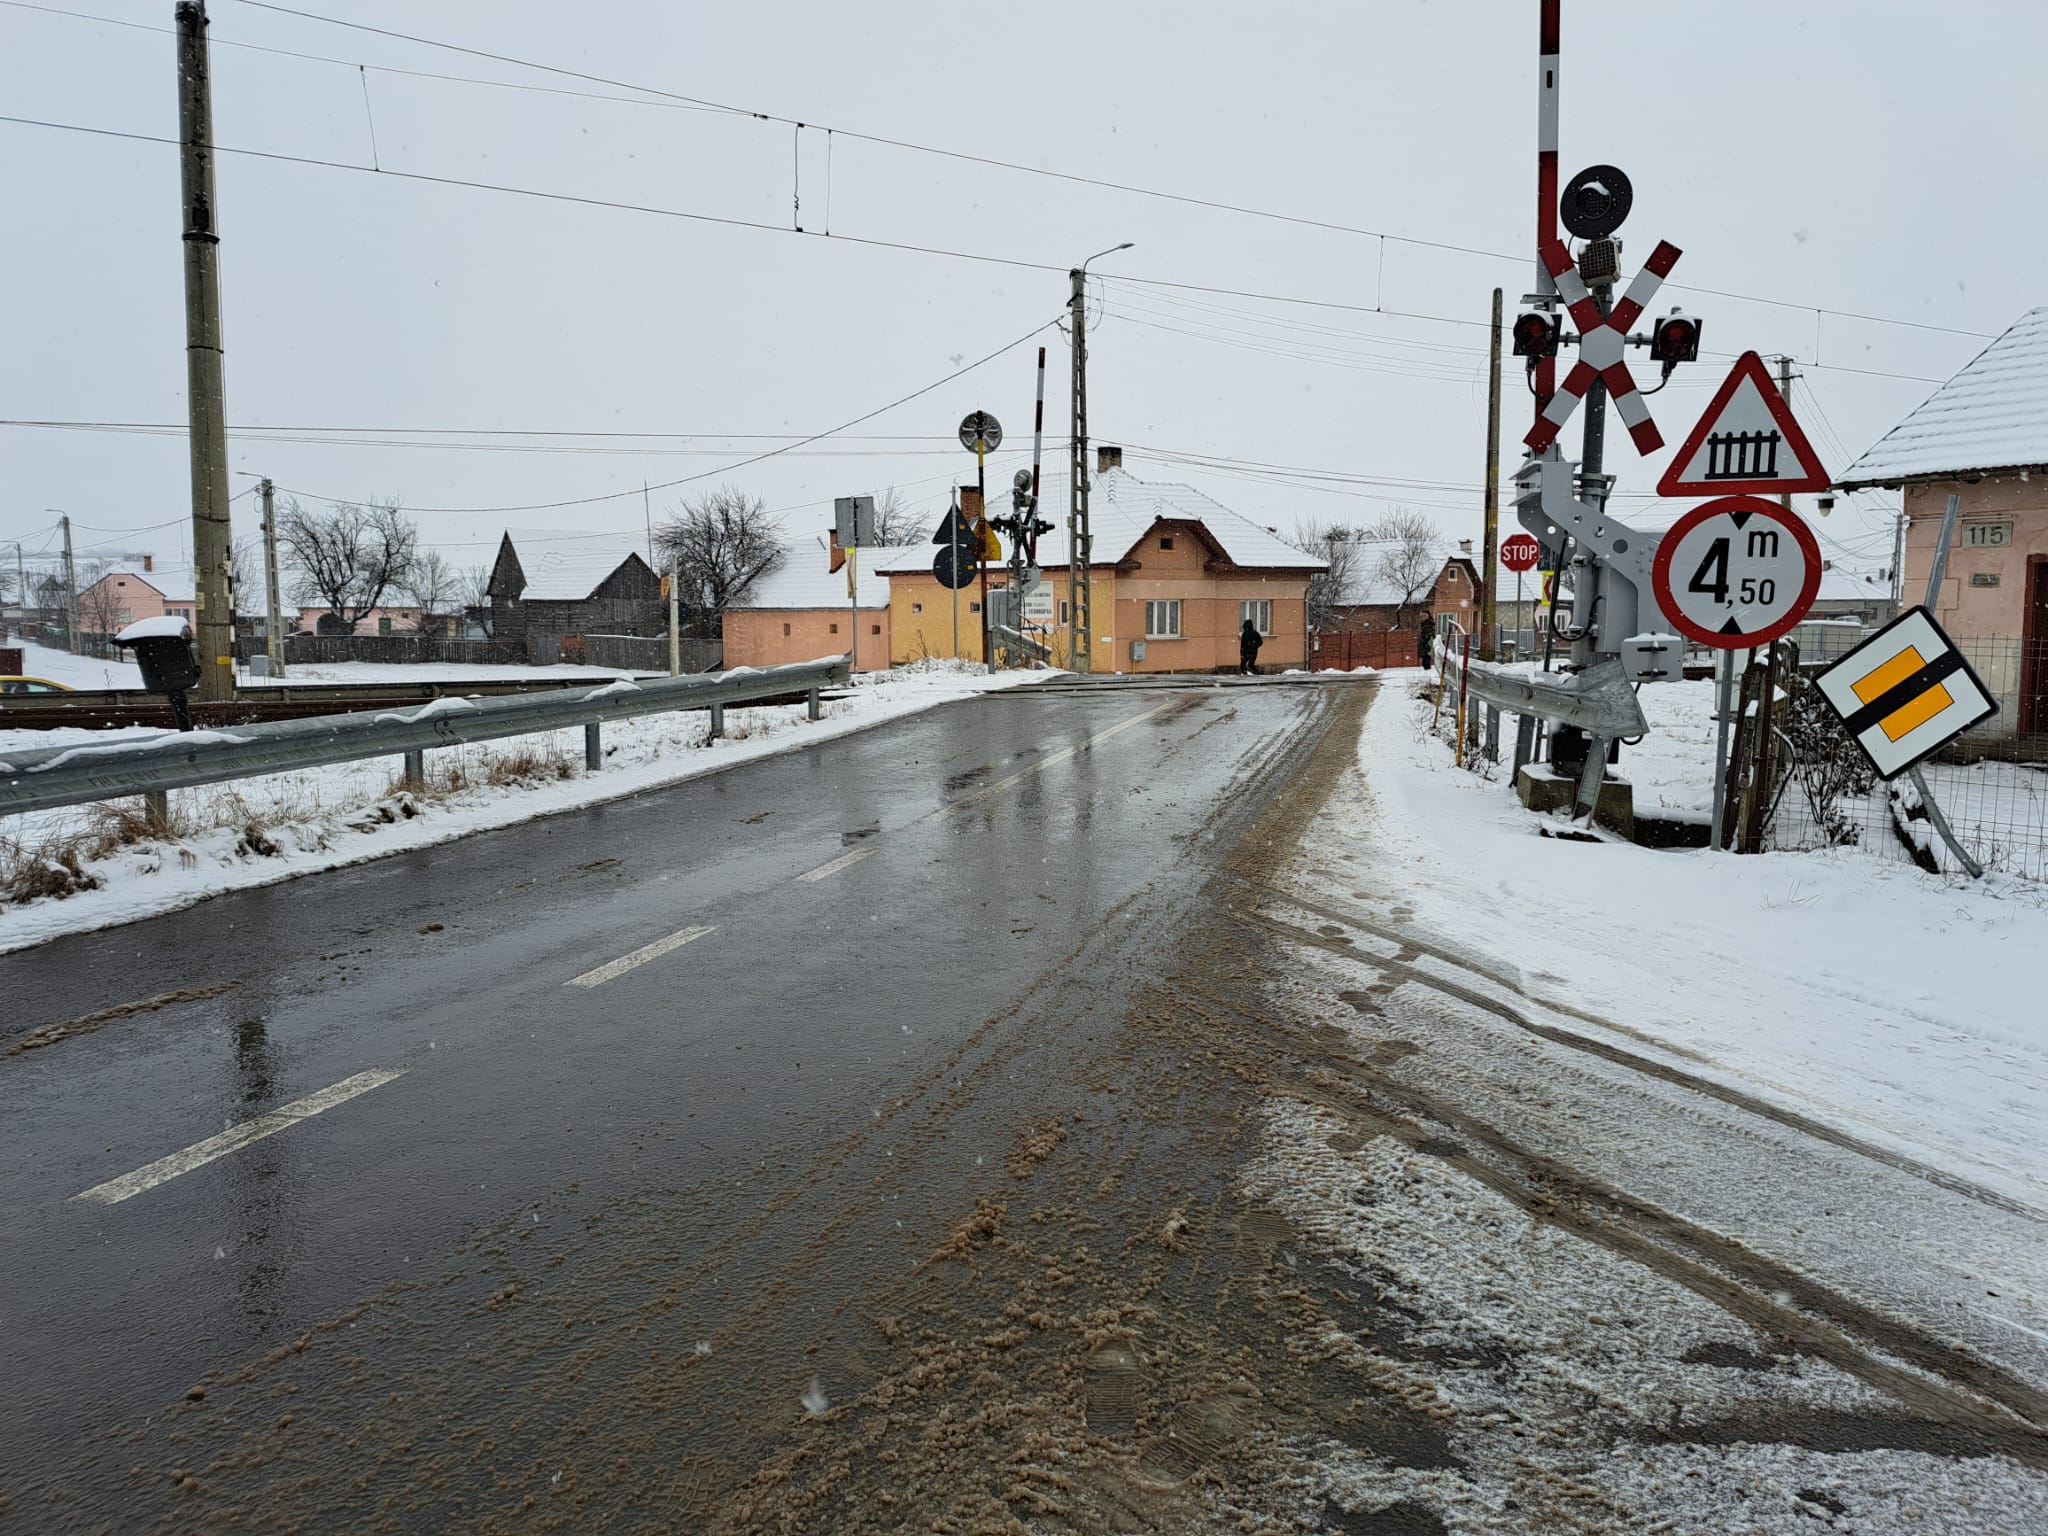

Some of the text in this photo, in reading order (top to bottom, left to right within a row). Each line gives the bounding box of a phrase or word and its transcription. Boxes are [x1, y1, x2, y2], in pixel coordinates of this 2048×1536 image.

[1747, 530, 1779, 558] m
[1969, 526, 2003, 545] 115
[1502, 545, 1538, 561] STOP
